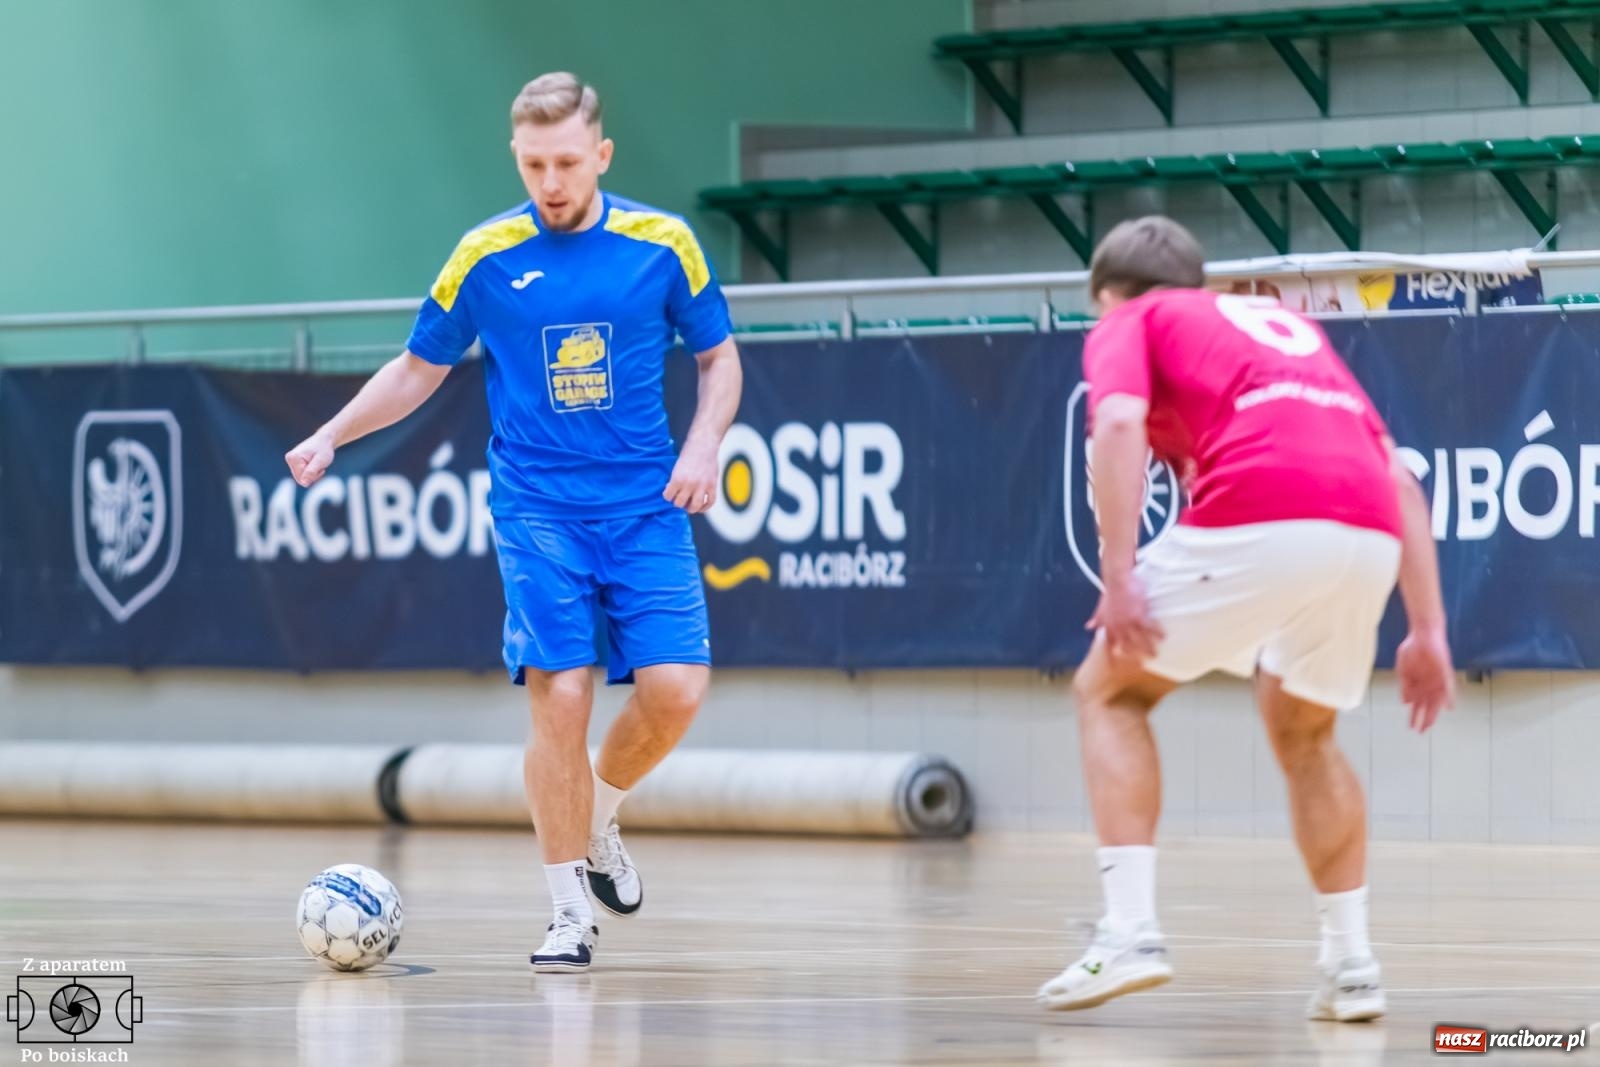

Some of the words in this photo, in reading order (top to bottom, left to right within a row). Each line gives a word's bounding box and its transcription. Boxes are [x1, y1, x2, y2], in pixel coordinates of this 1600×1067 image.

[1215, 294, 1322, 356] 6
[704, 420, 907, 544] OSiR
[777, 542, 906, 588] RACIBÓRZ
